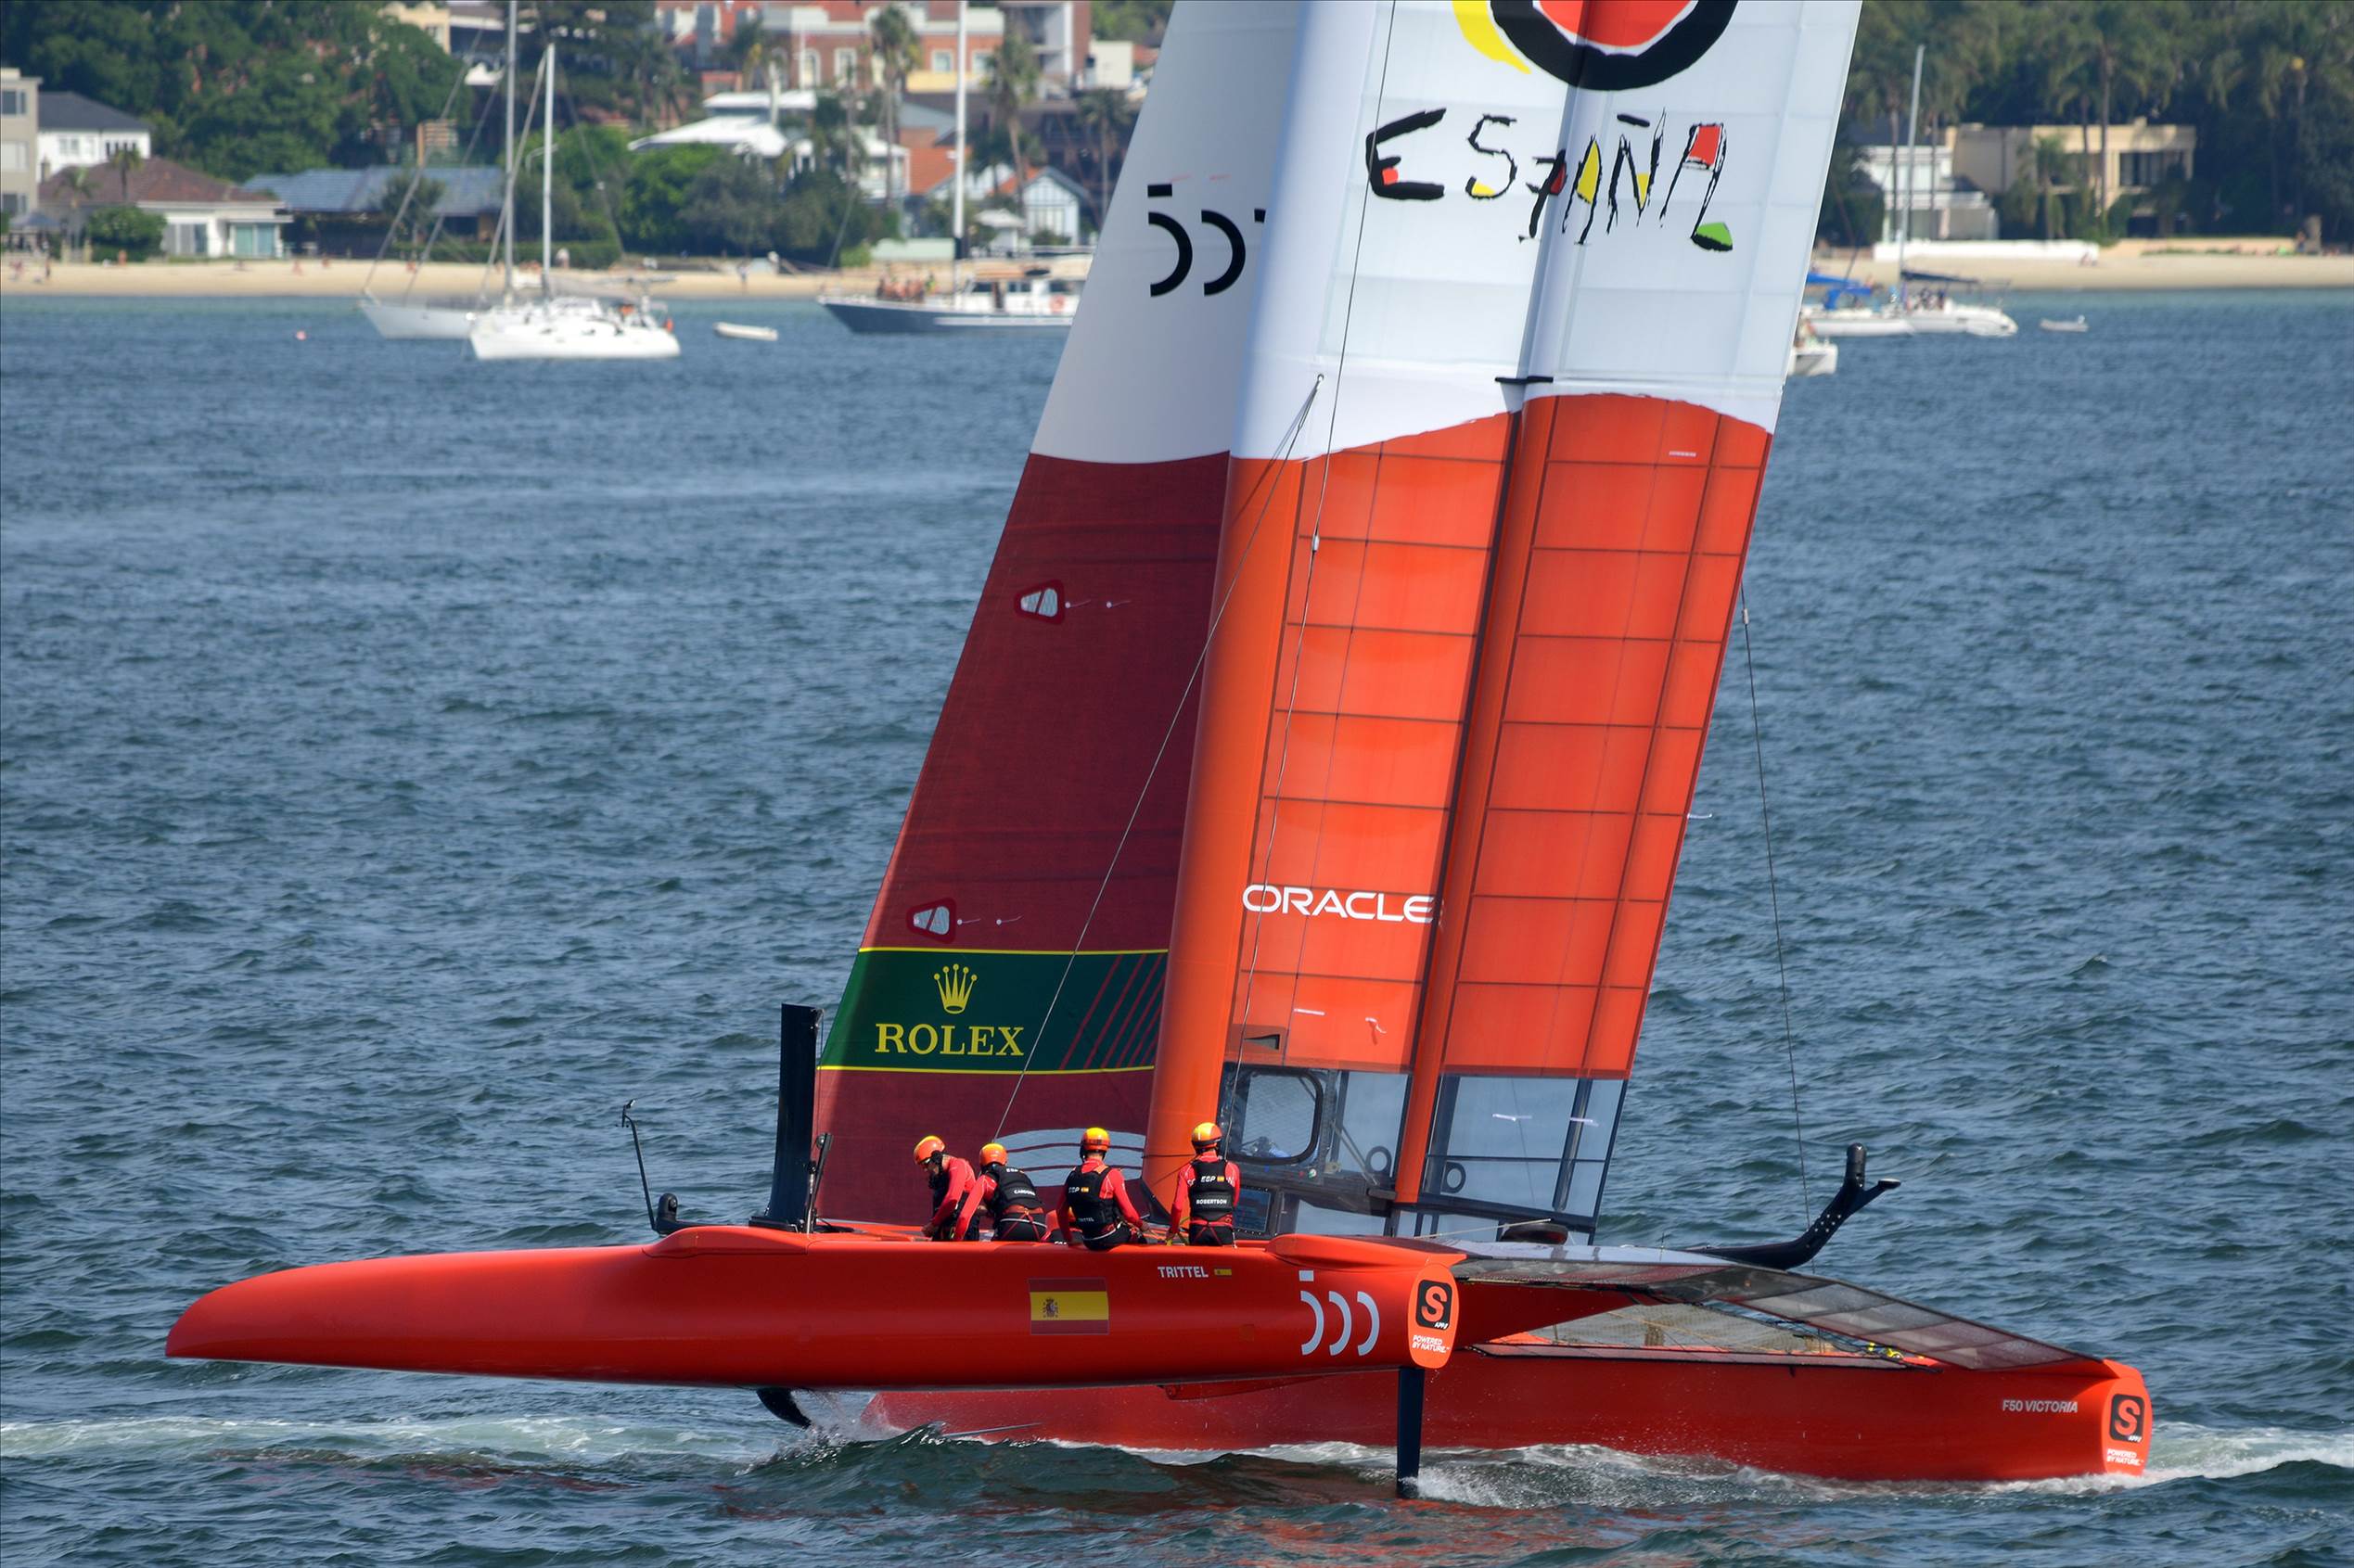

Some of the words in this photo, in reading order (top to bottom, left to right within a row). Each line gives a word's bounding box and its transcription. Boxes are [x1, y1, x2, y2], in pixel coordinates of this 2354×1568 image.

[1365, 107, 1734, 252] ESPAÑA
[1242, 884, 1435, 924] ORACLE
[875, 1023, 1024, 1056] ROLEX
[1200, 1175, 1216, 1183] ESP
[1157, 1266, 1209, 1278] TRITTEL
[1412, 1341, 1422, 1349] BY
[1413, 1334, 1443, 1345] POWERED
[2002, 1399, 2024, 1411] F50
[2026, 1400, 2079, 1413] VICTORIA
[2106, 1448, 2137, 1459] POWERED
